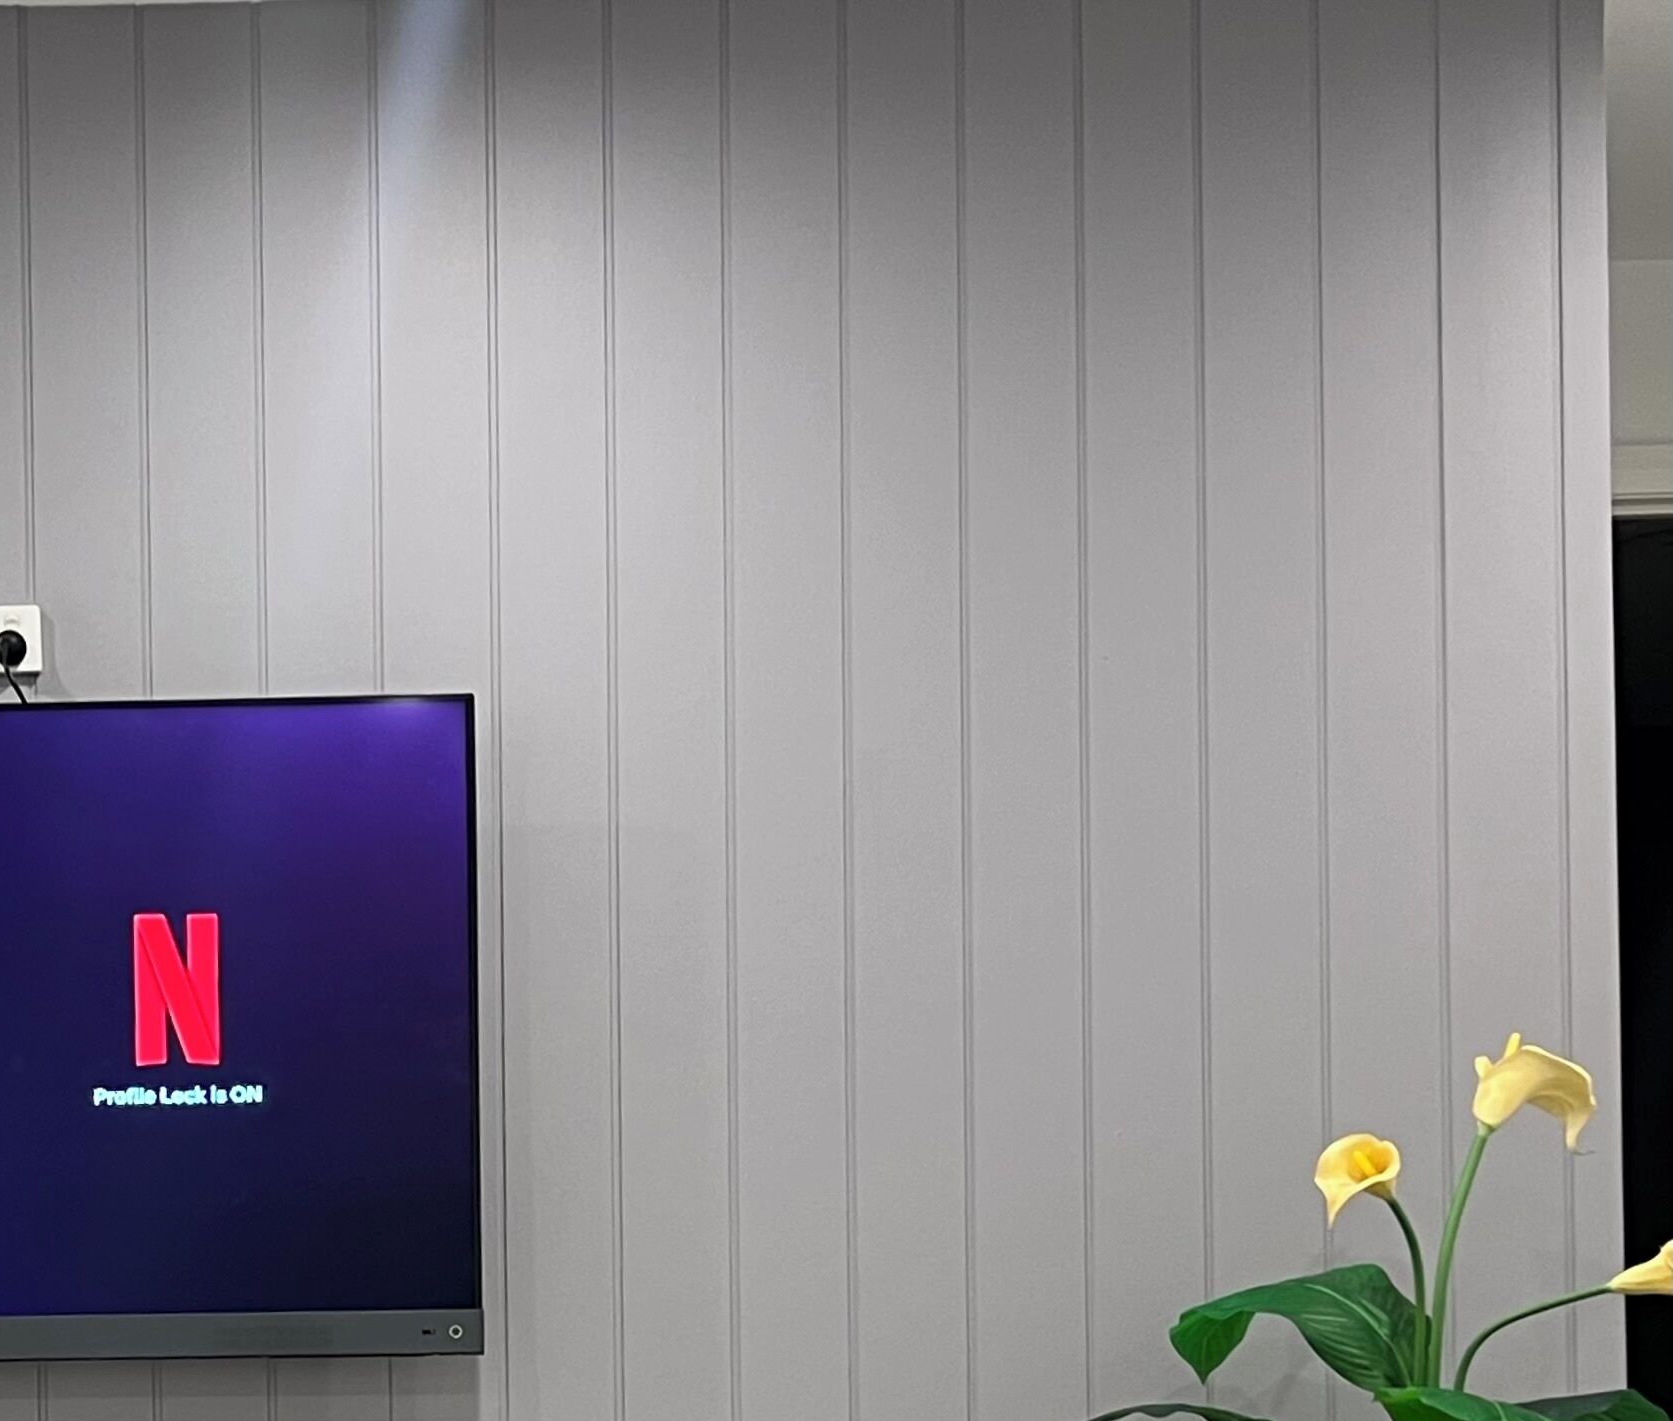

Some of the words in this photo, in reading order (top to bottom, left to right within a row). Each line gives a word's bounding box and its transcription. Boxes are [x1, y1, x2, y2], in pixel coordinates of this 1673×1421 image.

[133, 913, 220, 1067] N
[93, 1087, 157, 1106] Profile
[159, 1085, 207, 1105] Lock
[210, 1084, 228, 1104] is
[229, 1085, 263, 1104] ON
